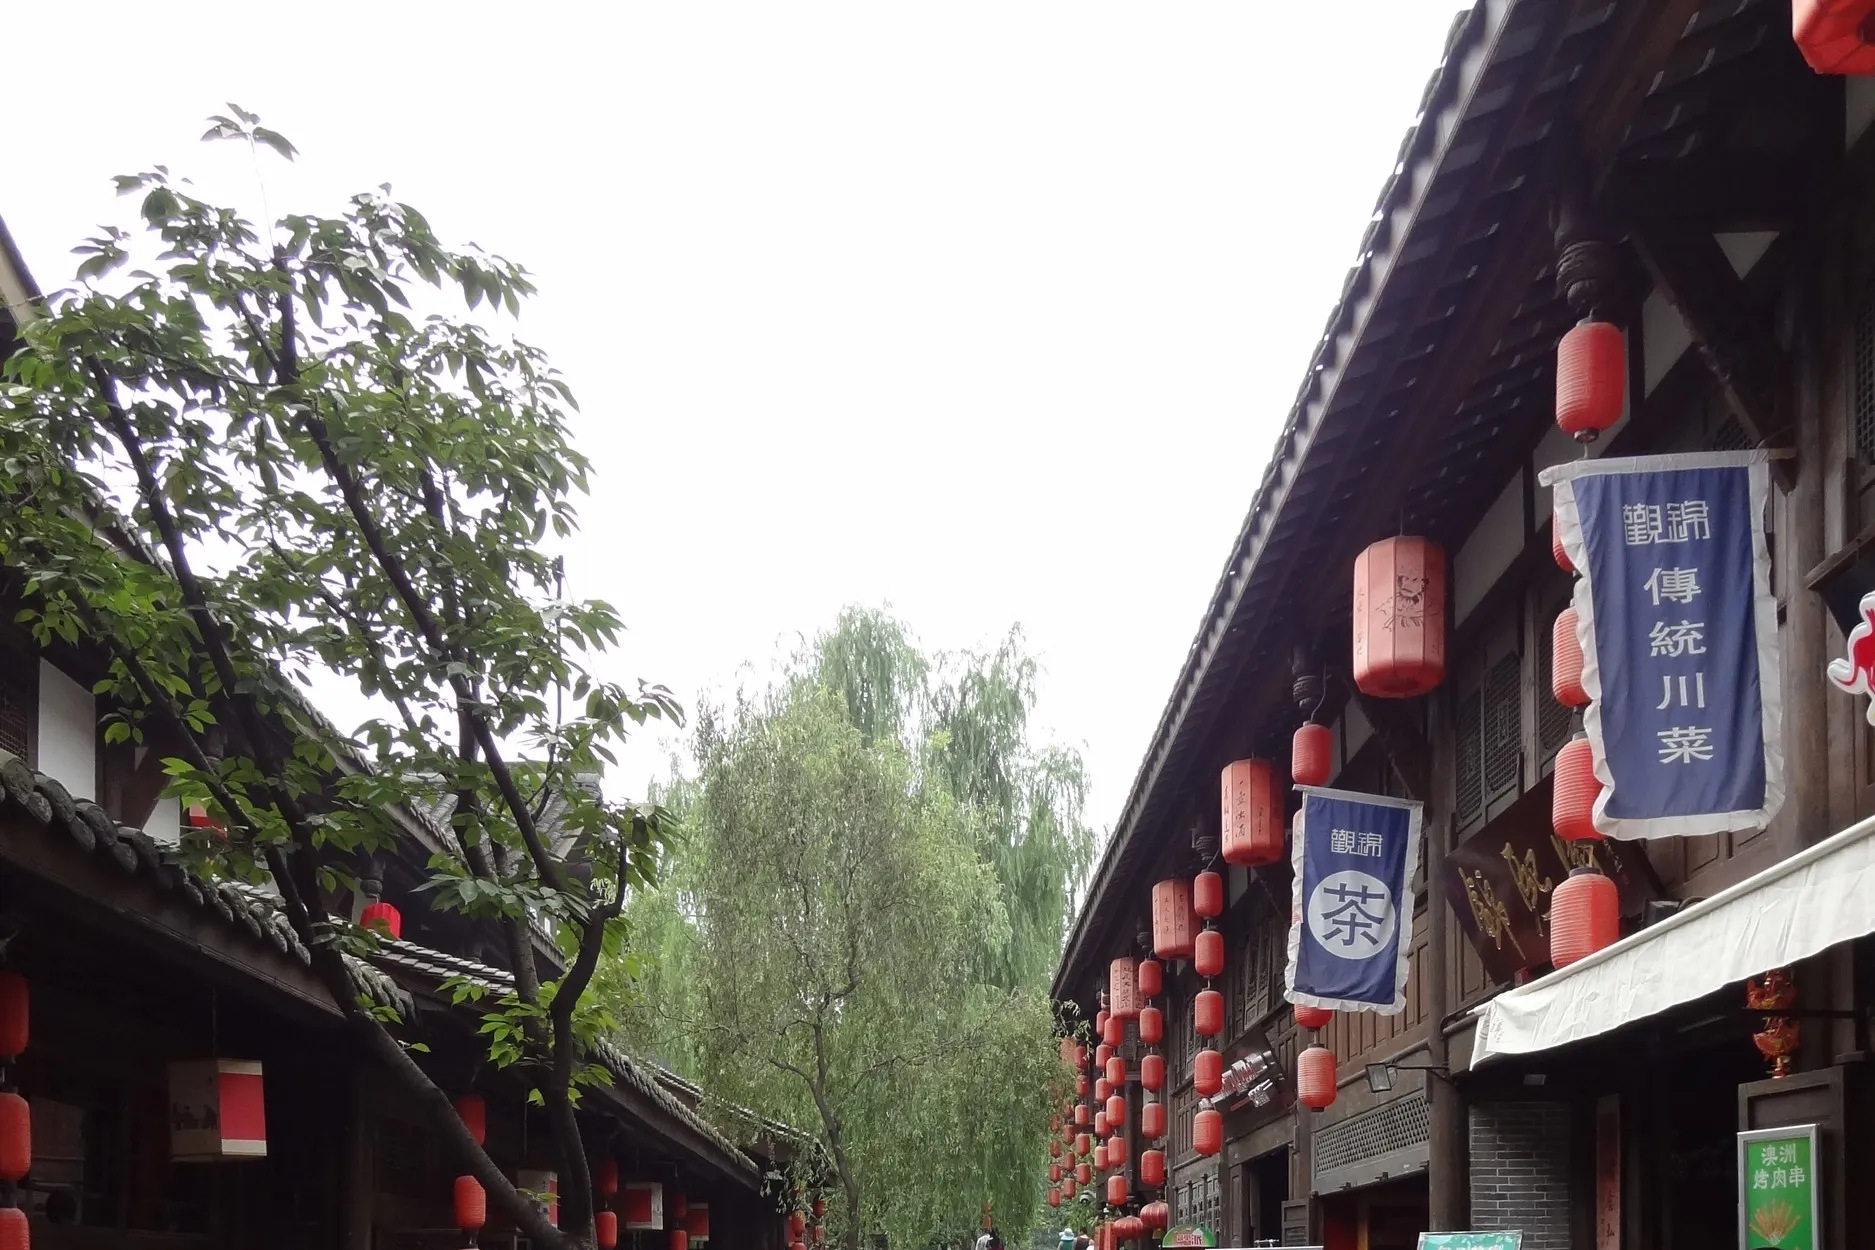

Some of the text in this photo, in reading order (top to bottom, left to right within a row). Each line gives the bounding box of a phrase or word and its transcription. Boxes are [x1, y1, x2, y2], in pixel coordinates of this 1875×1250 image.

[1643, 566, 1714, 764] 傳統川菜
[1320, 882, 1385, 946] 茶
[1760, 1142, 1797, 1167] 澳洲
[1753, 1165, 1805, 1190] 烤肉串
